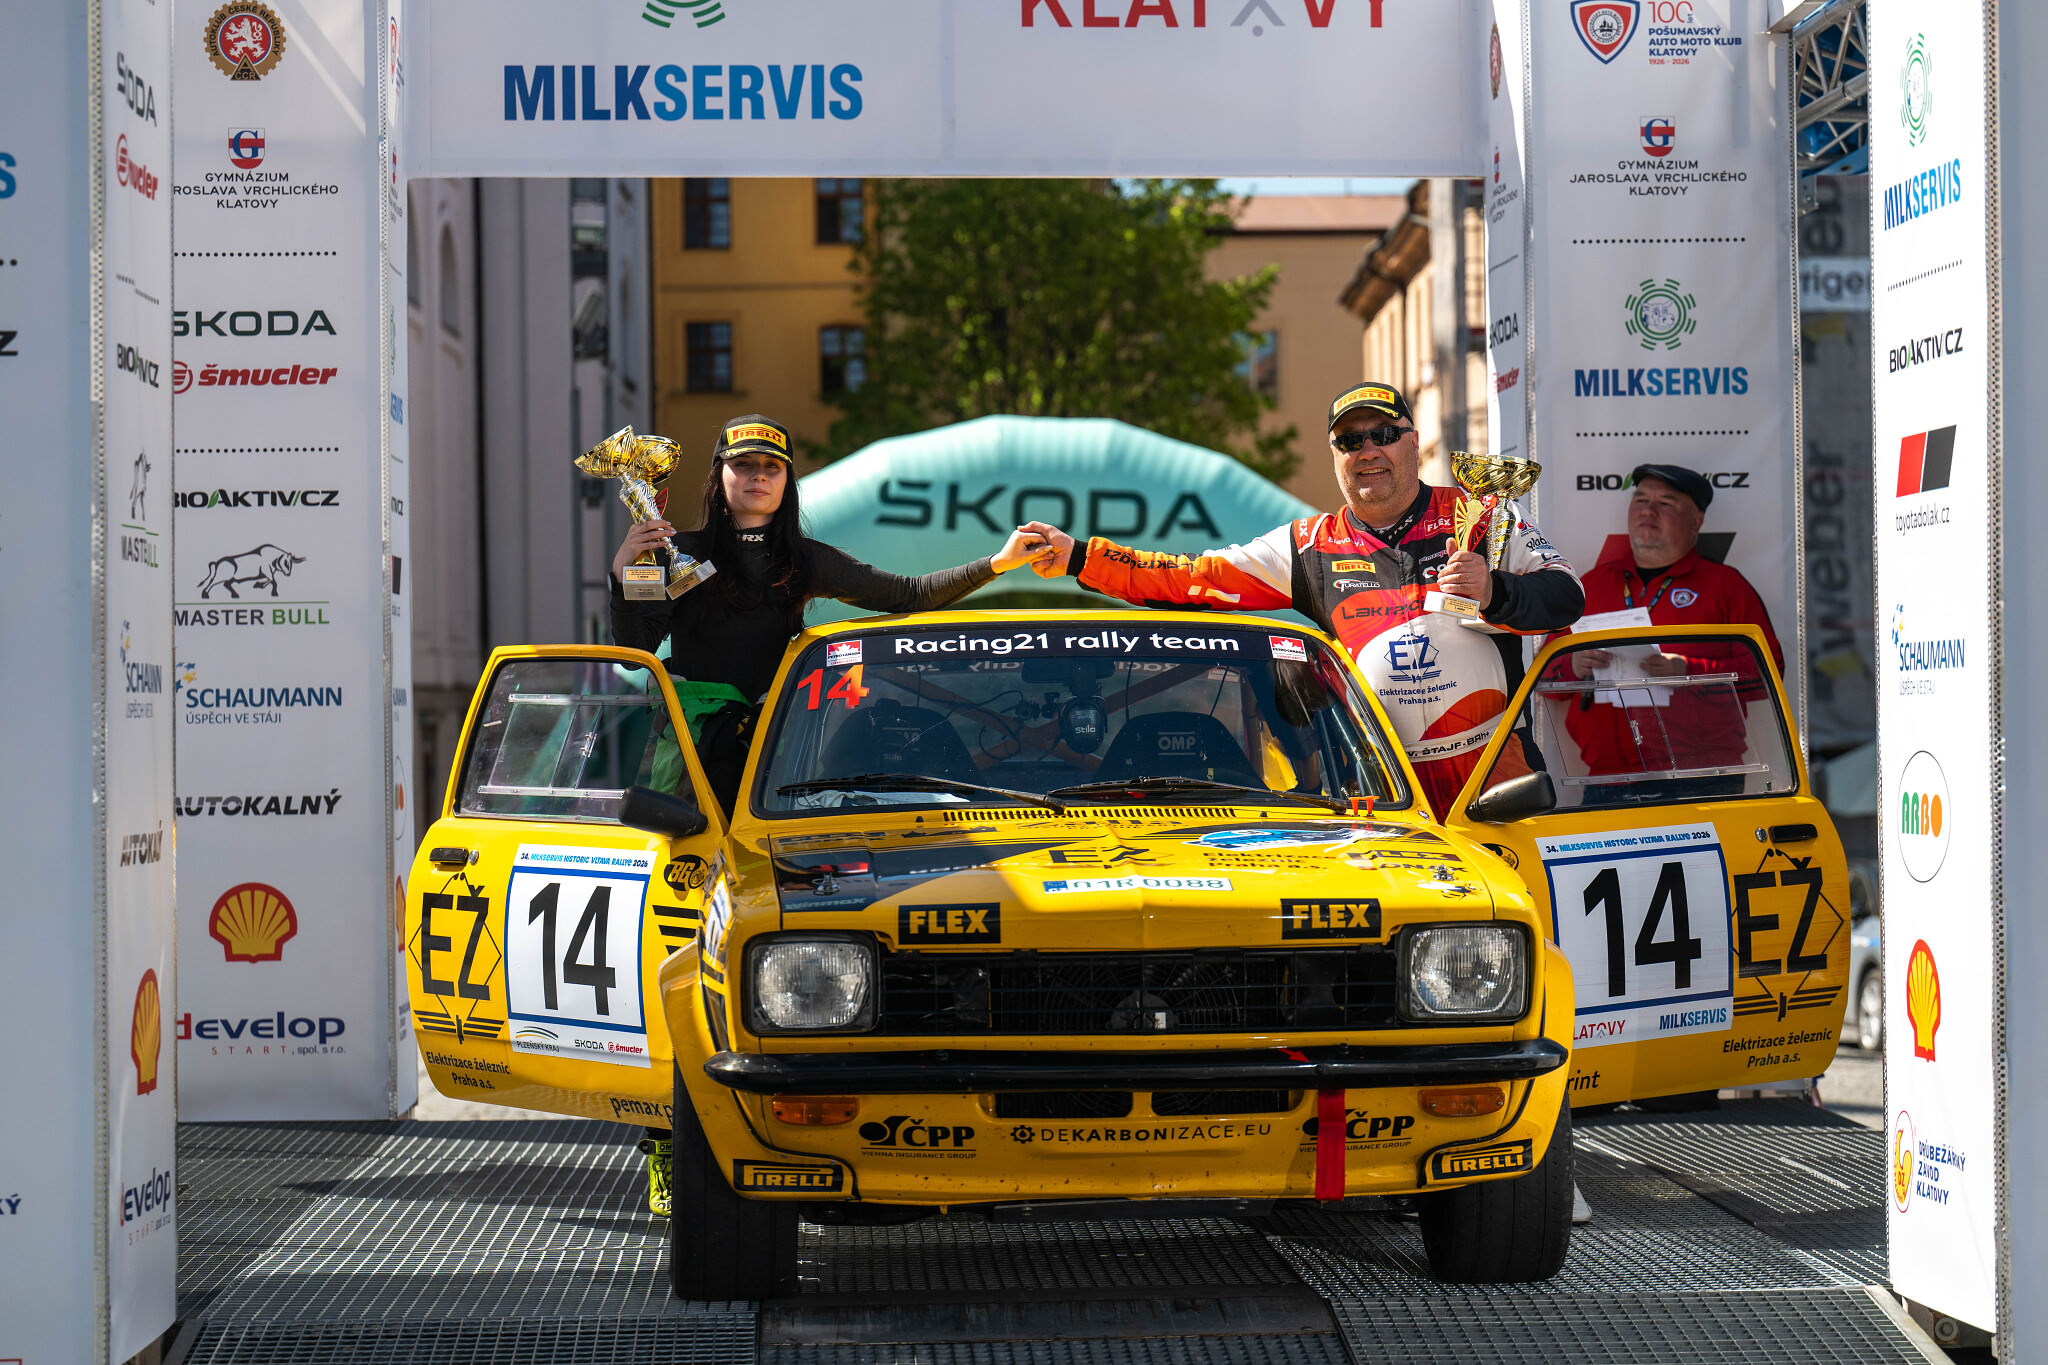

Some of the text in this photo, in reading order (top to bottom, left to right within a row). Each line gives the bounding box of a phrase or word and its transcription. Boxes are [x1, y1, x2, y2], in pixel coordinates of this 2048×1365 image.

[209, 13, 227, 56] AUTOKLUB
[227, 3, 258, 15] ČESKÉ
[1648, 25, 1722, 36] POŠUMAVSKÝ
[1648, 37, 1743, 47] AUTO MOTO KLUB
[1648, 48, 1698, 57] KLATOVY
[503, 63, 864, 122] MILKSERVIS
[1644, 118, 1673, 148] G
[231, 129, 260, 160] G
[1618, 158, 1699, 171] GYMNÁZIUM
[205, 170, 290, 183] GYMNÁZIUM
[1569, 170, 1748, 184] JAROSLAVA VRCHLICKÉHO
[242, 182, 339, 196] VRCHLICKÉHO
[1629, 186, 1689, 196] KLATOVY
[1883, 158, 1962, 232] MILKSERVIS
[216, 199, 279, 209] KLATOVY
[1574, 366, 1749, 397] MILKSERVIS
[1335, 389, 1392, 411] PIRELLI
[731, 427, 783, 445] PIRELLI
[1427, 517, 1452, 532] FLEX
[1895, 503, 1951, 537] toyotadolak.cz
[1335, 561, 1373, 571] PIRELLI
[175, 608, 330, 626] MASTER BULL
[894, 631, 1240, 656] Racing21 rally team
[1899, 638, 1965, 671] SCHAUMANN
[185, 686, 343, 709] SCHAUMANN
[797, 664, 870, 711] 14
[186, 710, 282, 725] ÚSPĚCH VE STÁJI
[1158, 735, 1197, 751] OMP
[1143, 878, 1225, 889] 0088
[908, 908, 989, 934] FLEX
[1292, 903, 1371, 929] FLEX
[1733, 857, 1828, 980] EŽ
[1583, 861, 1702, 998] 14
[421, 884, 491, 1001] EŽ
[528, 882, 617, 1017] 14
[1659, 1008, 1728, 1031] MILKSERVIS
[296, 1043, 320, 1056] spol.
[330, 1045, 347, 1055] r.o.
[1722, 1028, 1833, 1054] Elektrizace železnic
[426, 1051, 511, 1076] Elektrizace železnic
[1746, 1053, 1801, 1069] Praha a.s.
[452, 1073, 496, 1090] Praha a.s.
[610, 1096, 660, 1118] pemax
[1040, 1123, 1271, 1142] DEKARBONIZACE.EU
[895, 1151, 946, 1159] INSURANCE
[946, 1152, 977, 1160] GROUP
[1382, 1140, 1412, 1150] GROUP
[1441, 1145, 1524, 1173] PIRELLI
[743, 1164, 834, 1187] PIRELLI
[1916, 1180, 1950, 1205] KLATOVY
